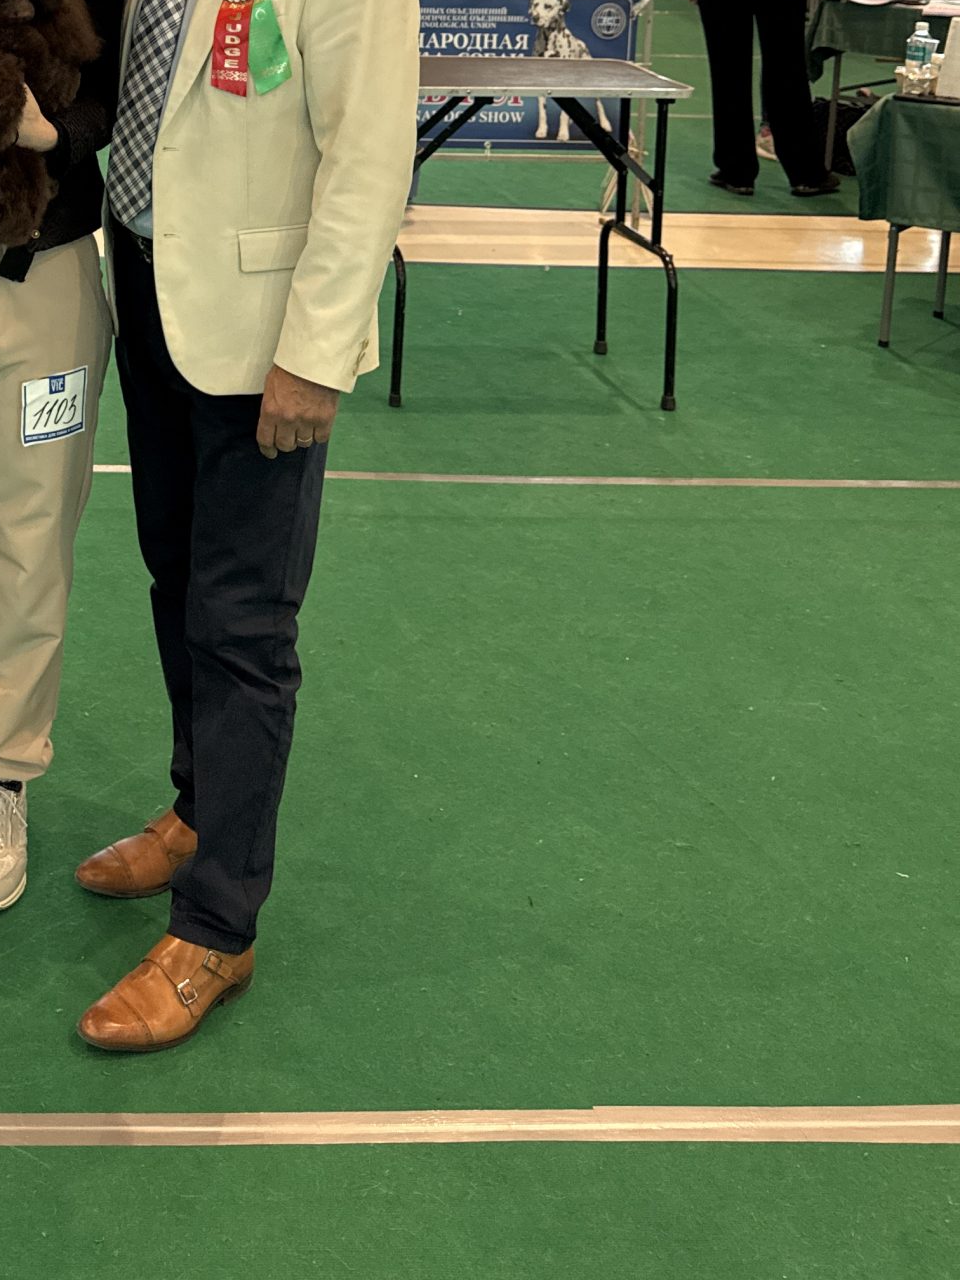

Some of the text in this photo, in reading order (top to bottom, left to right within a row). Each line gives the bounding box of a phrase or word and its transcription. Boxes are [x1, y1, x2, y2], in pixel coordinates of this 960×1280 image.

[470, 21, 497, 30] UNION
[224, 11, 242, 69] JUDGE
[479, 110, 525, 124] SHOW
